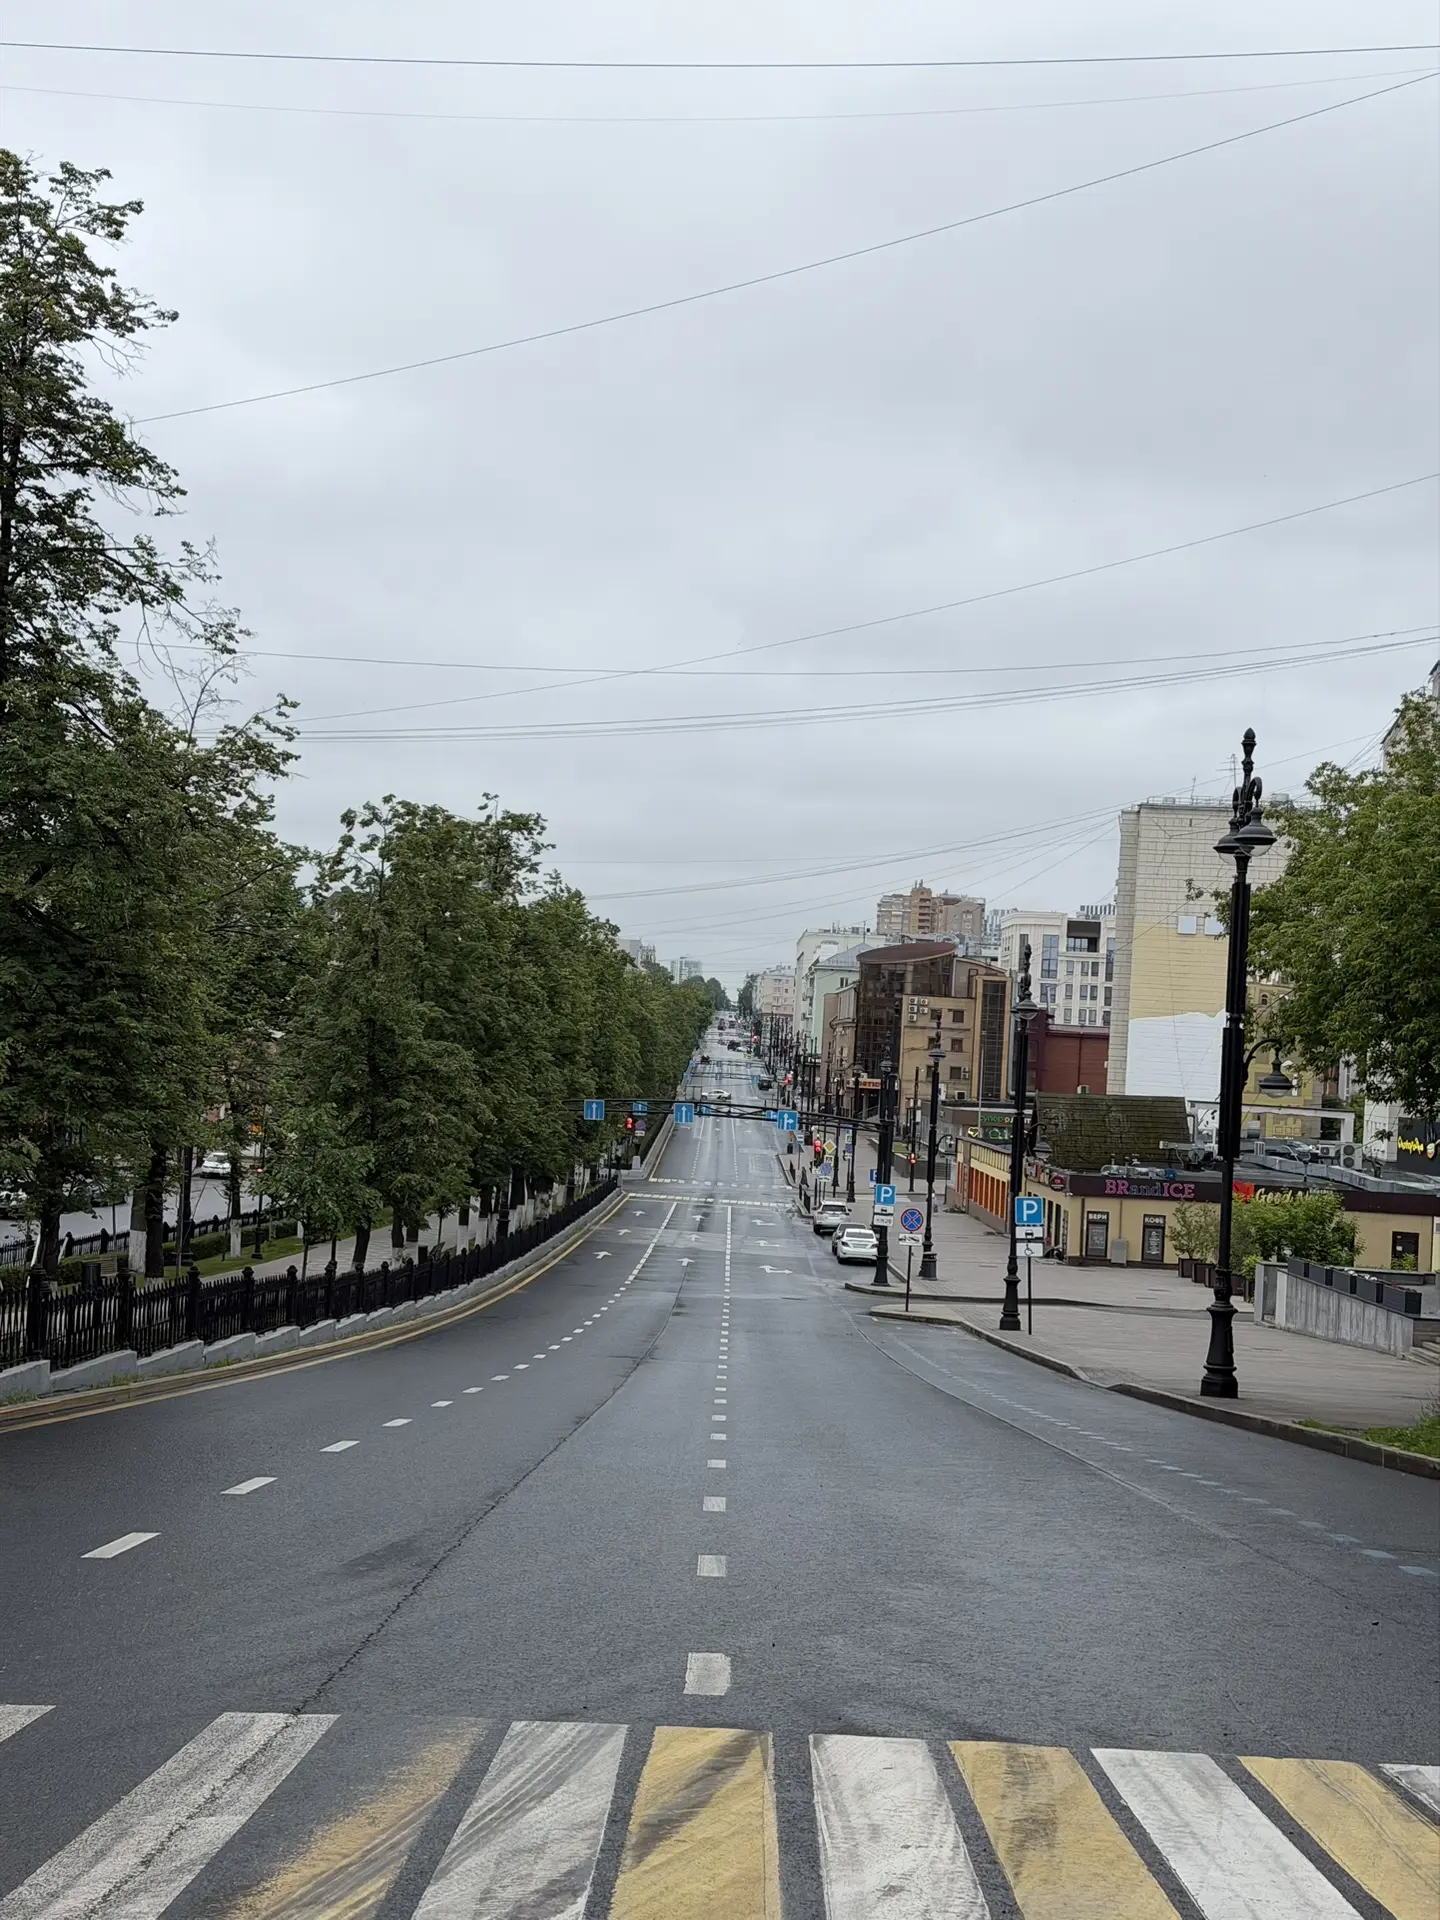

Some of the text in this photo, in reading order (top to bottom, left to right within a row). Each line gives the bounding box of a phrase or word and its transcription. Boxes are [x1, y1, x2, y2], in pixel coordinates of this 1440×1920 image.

[881, 1187, 892, 1203] P
[1105, 1179, 1195, 1198] BRandICE
[1023, 1200, 1038, 1221] P
